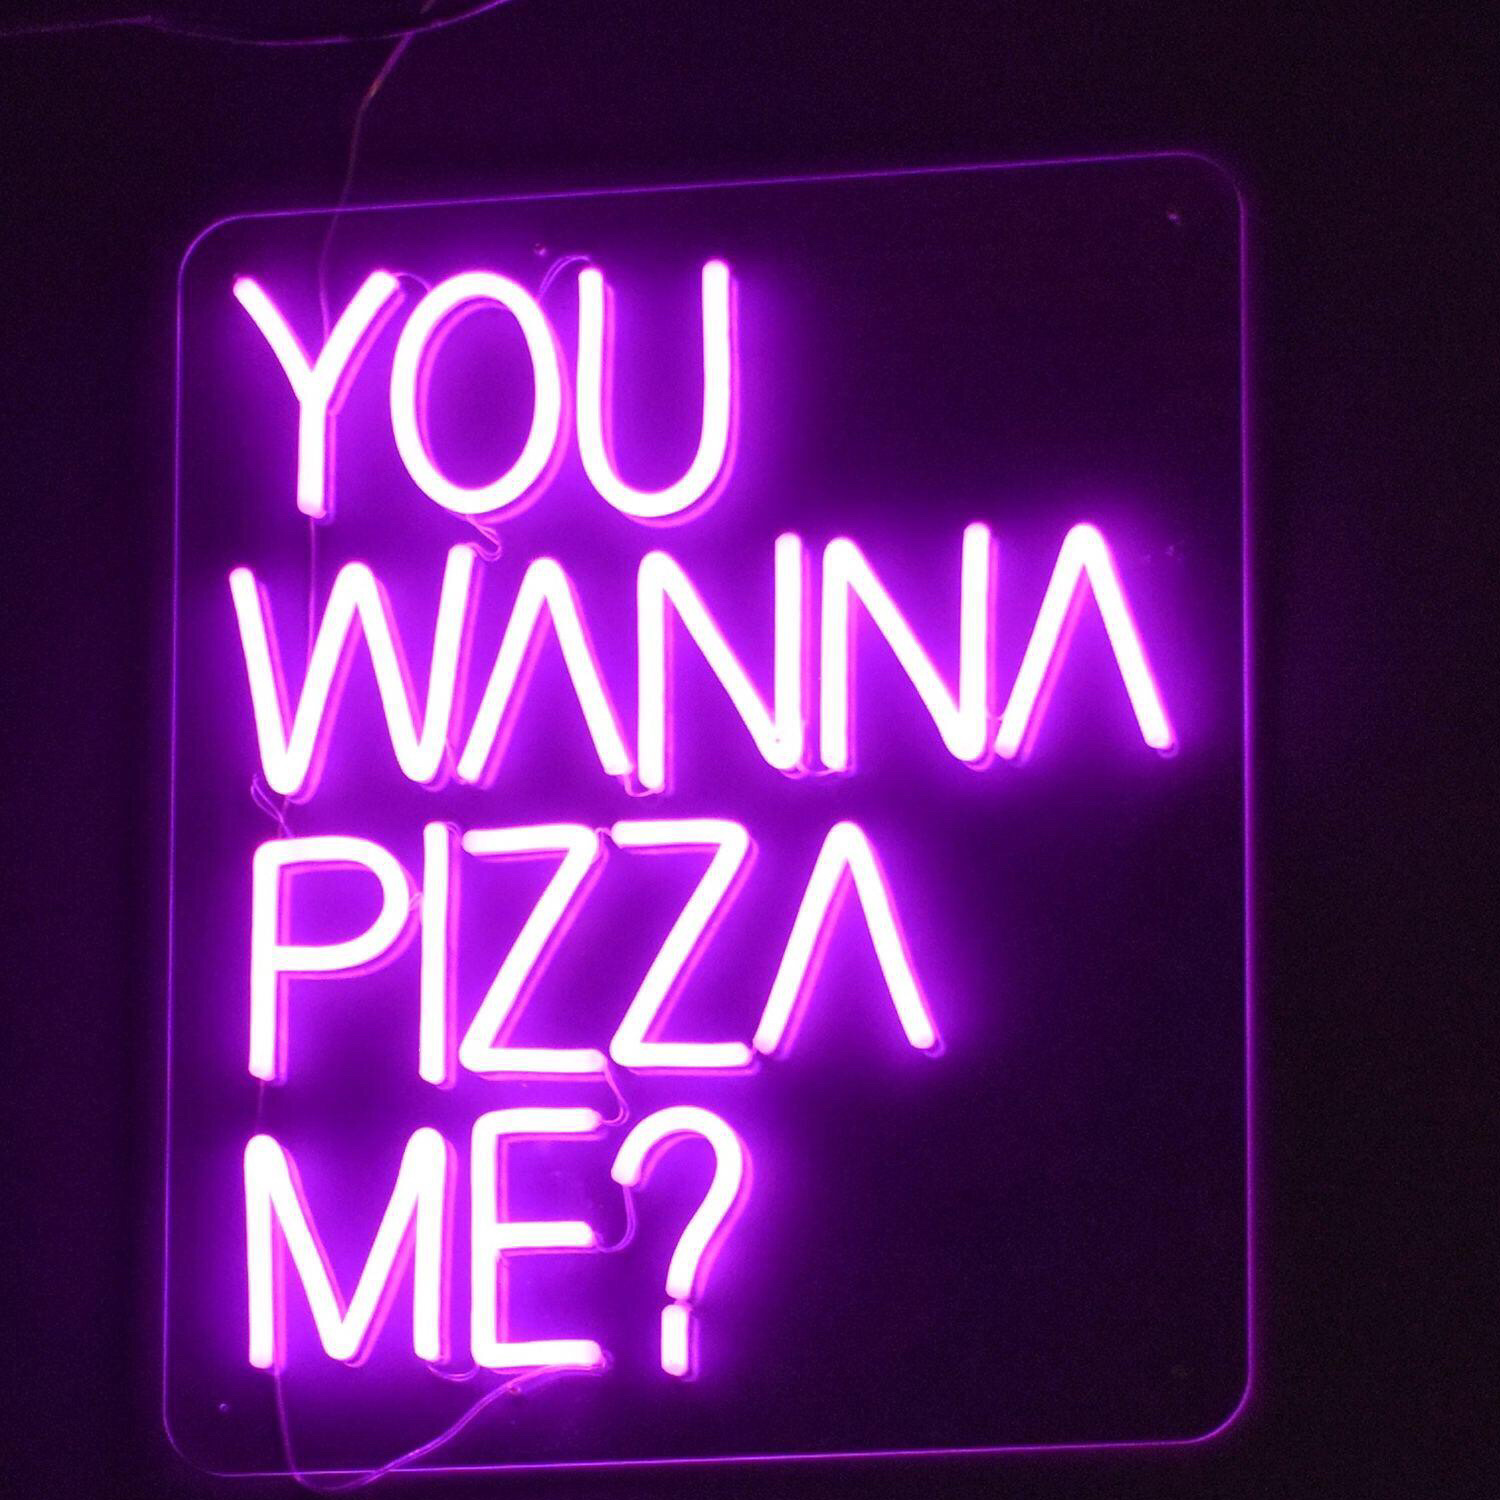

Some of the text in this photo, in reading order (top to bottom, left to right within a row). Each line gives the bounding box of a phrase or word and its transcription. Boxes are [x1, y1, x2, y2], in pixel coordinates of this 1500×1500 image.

[230, 256, 734, 524] YOU
[228, 521, 1176, 798] WANNA
[248, 819, 942, 1086] PIZZA
[242, 1104, 748, 1378] ME?
